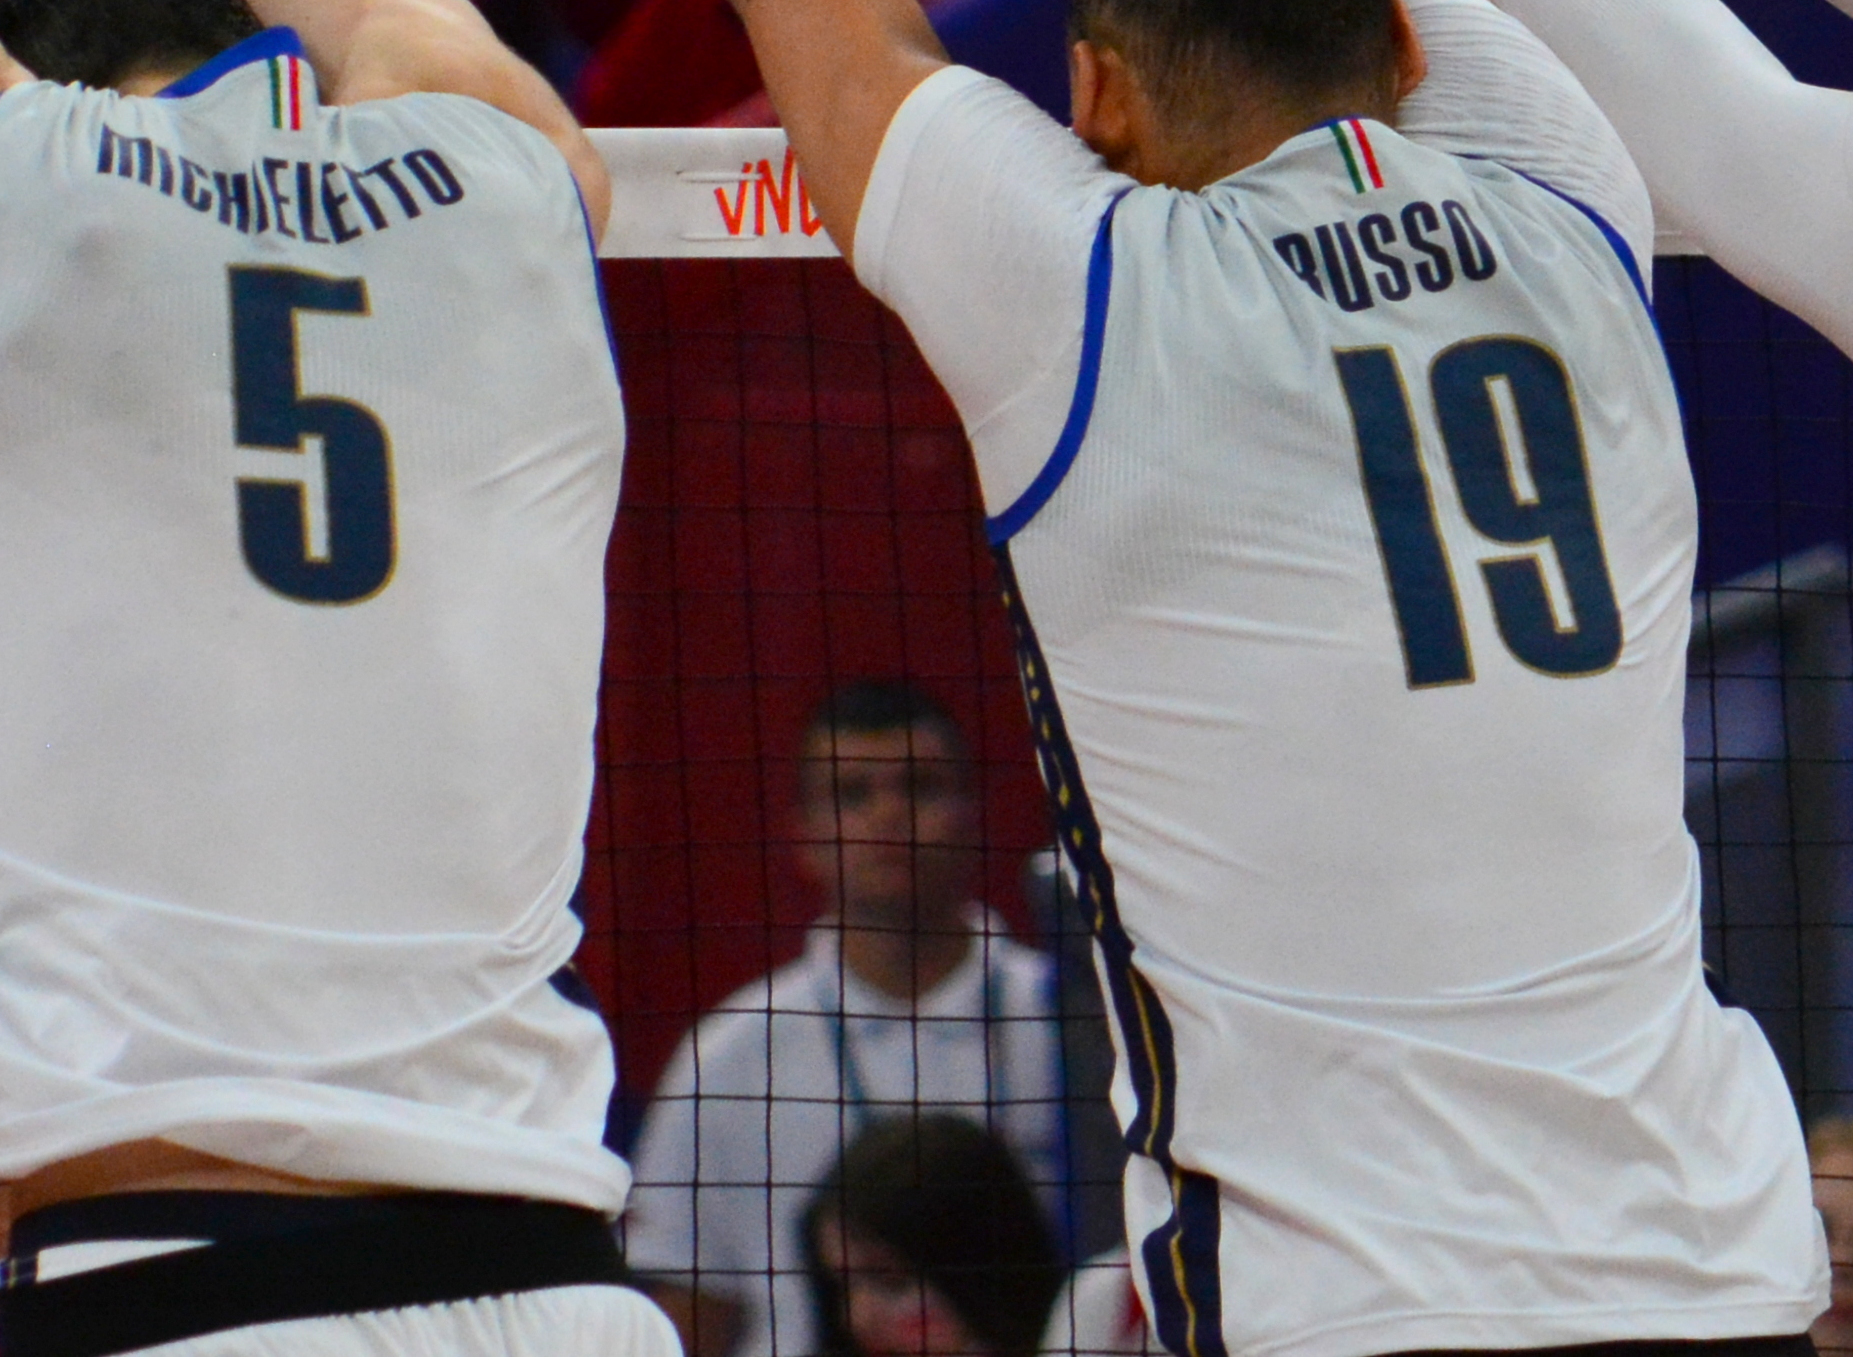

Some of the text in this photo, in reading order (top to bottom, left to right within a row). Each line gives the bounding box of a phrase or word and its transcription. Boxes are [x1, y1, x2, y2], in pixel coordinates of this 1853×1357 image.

[97, 122, 464, 245] MICHIELETTO
[1272, 199, 1498, 313] RUSSO
[227, 262, 397, 608] 5
[1332, 334, 1623, 690] 19
